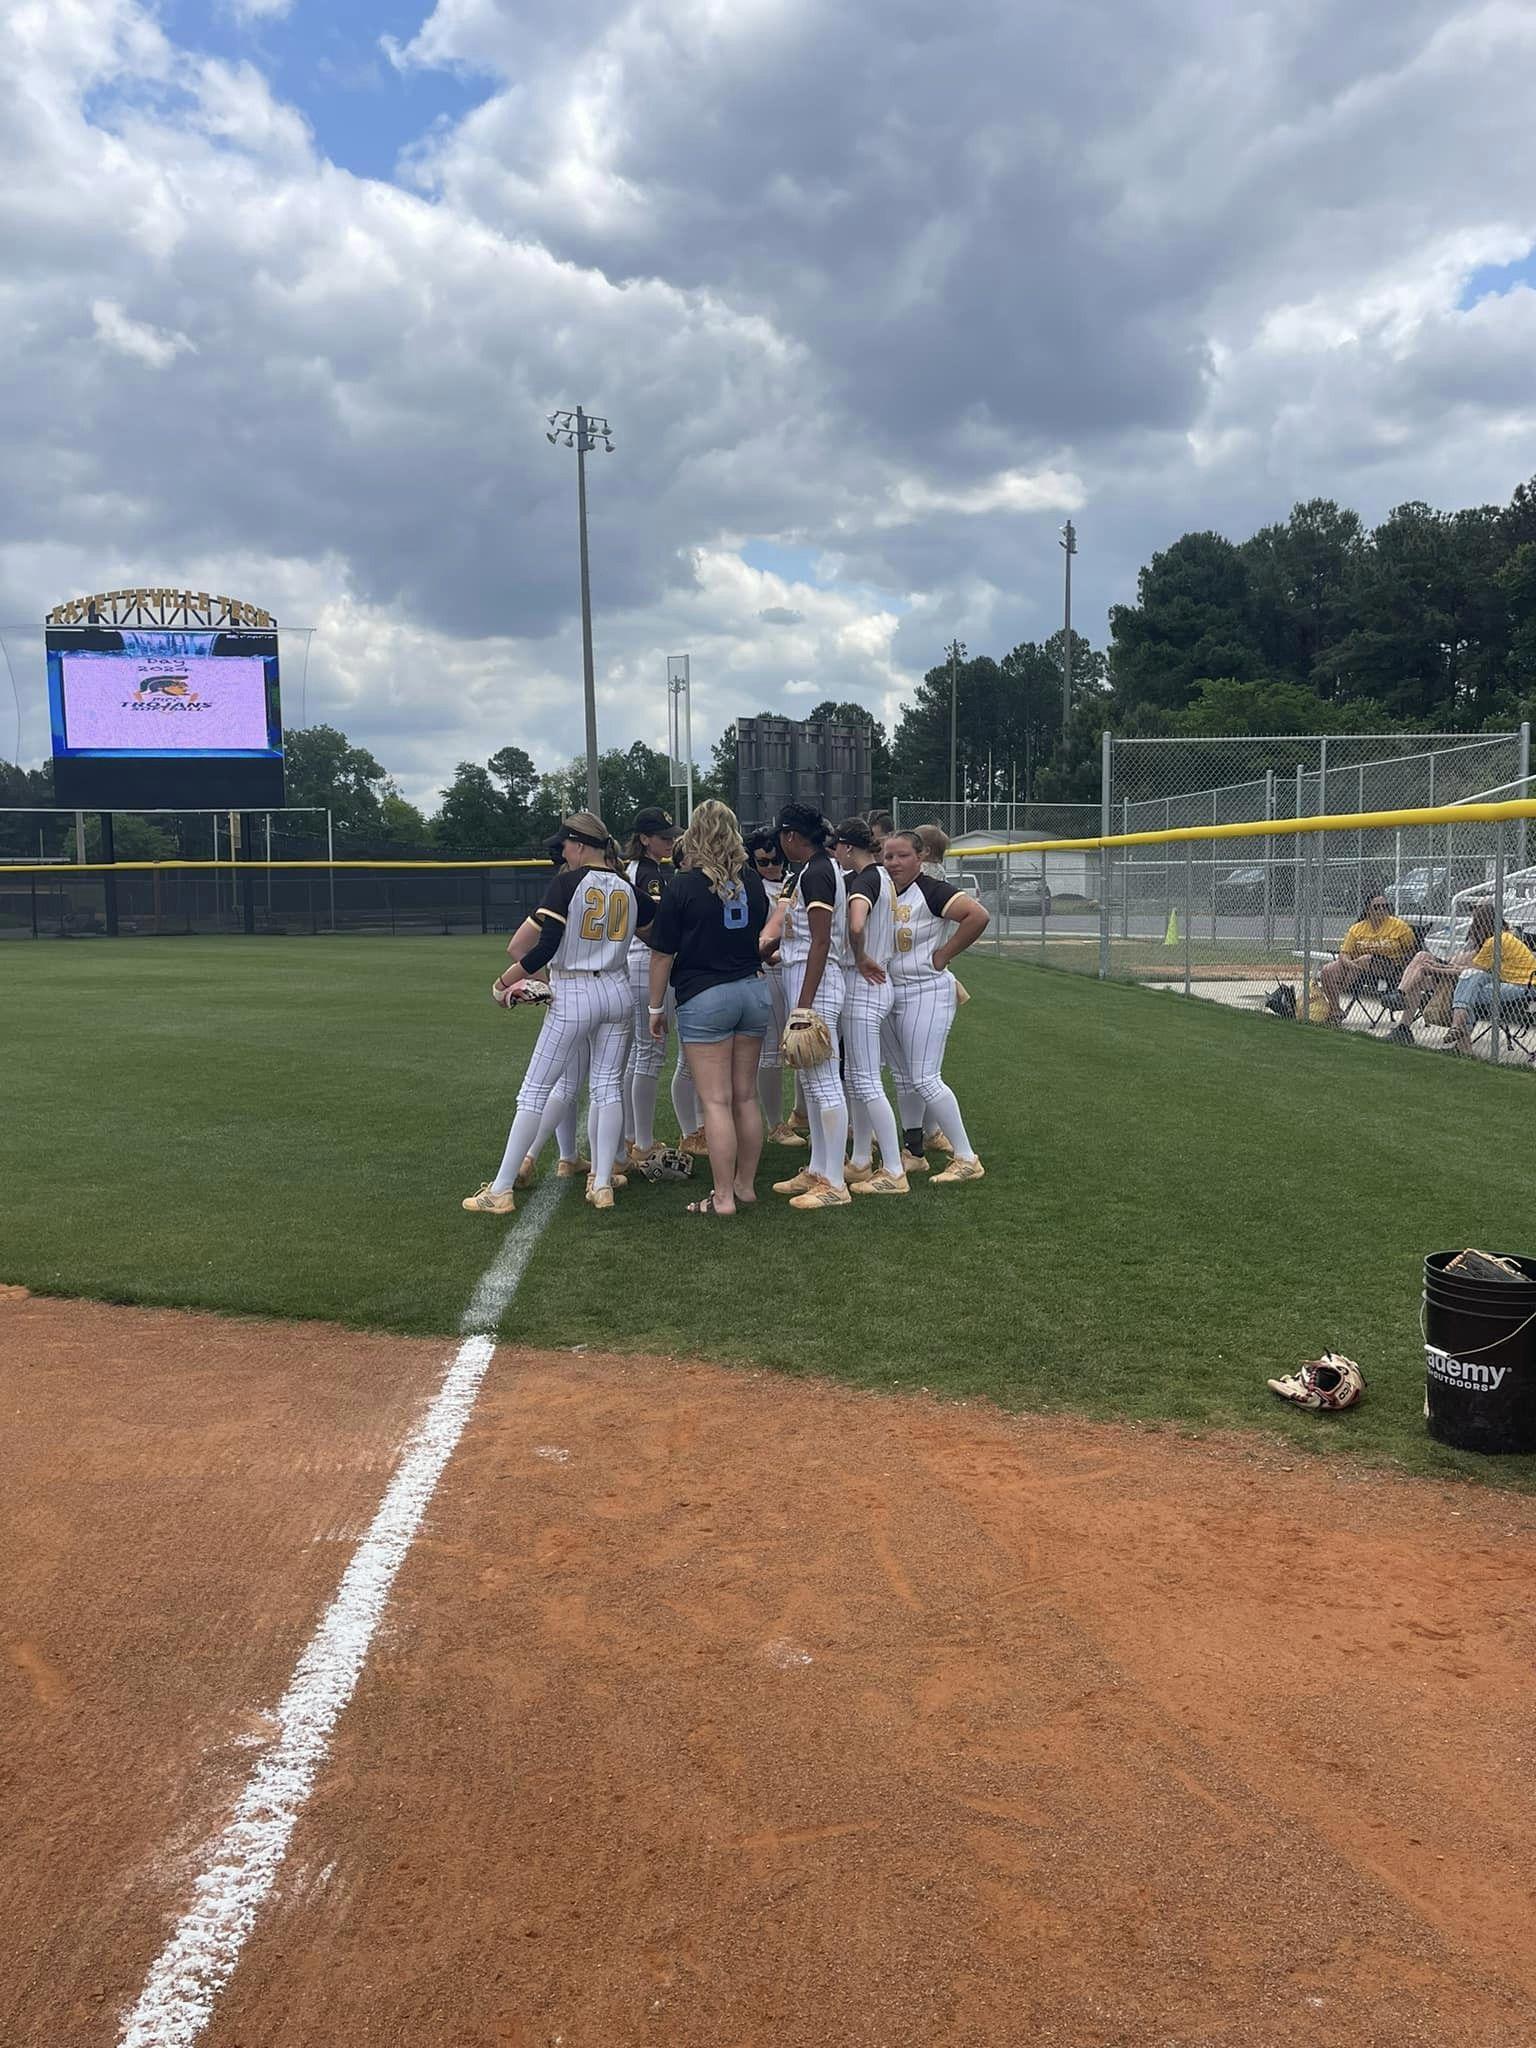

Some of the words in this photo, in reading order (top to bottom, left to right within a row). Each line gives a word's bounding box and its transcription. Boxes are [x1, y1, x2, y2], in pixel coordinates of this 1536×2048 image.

[53, 588, 209, 624] FAYETTEVILLE
[216, 595, 269, 627] TECH
[121, 702, 212, 711] TROJANS
[580, 886, 629, 942] 20
